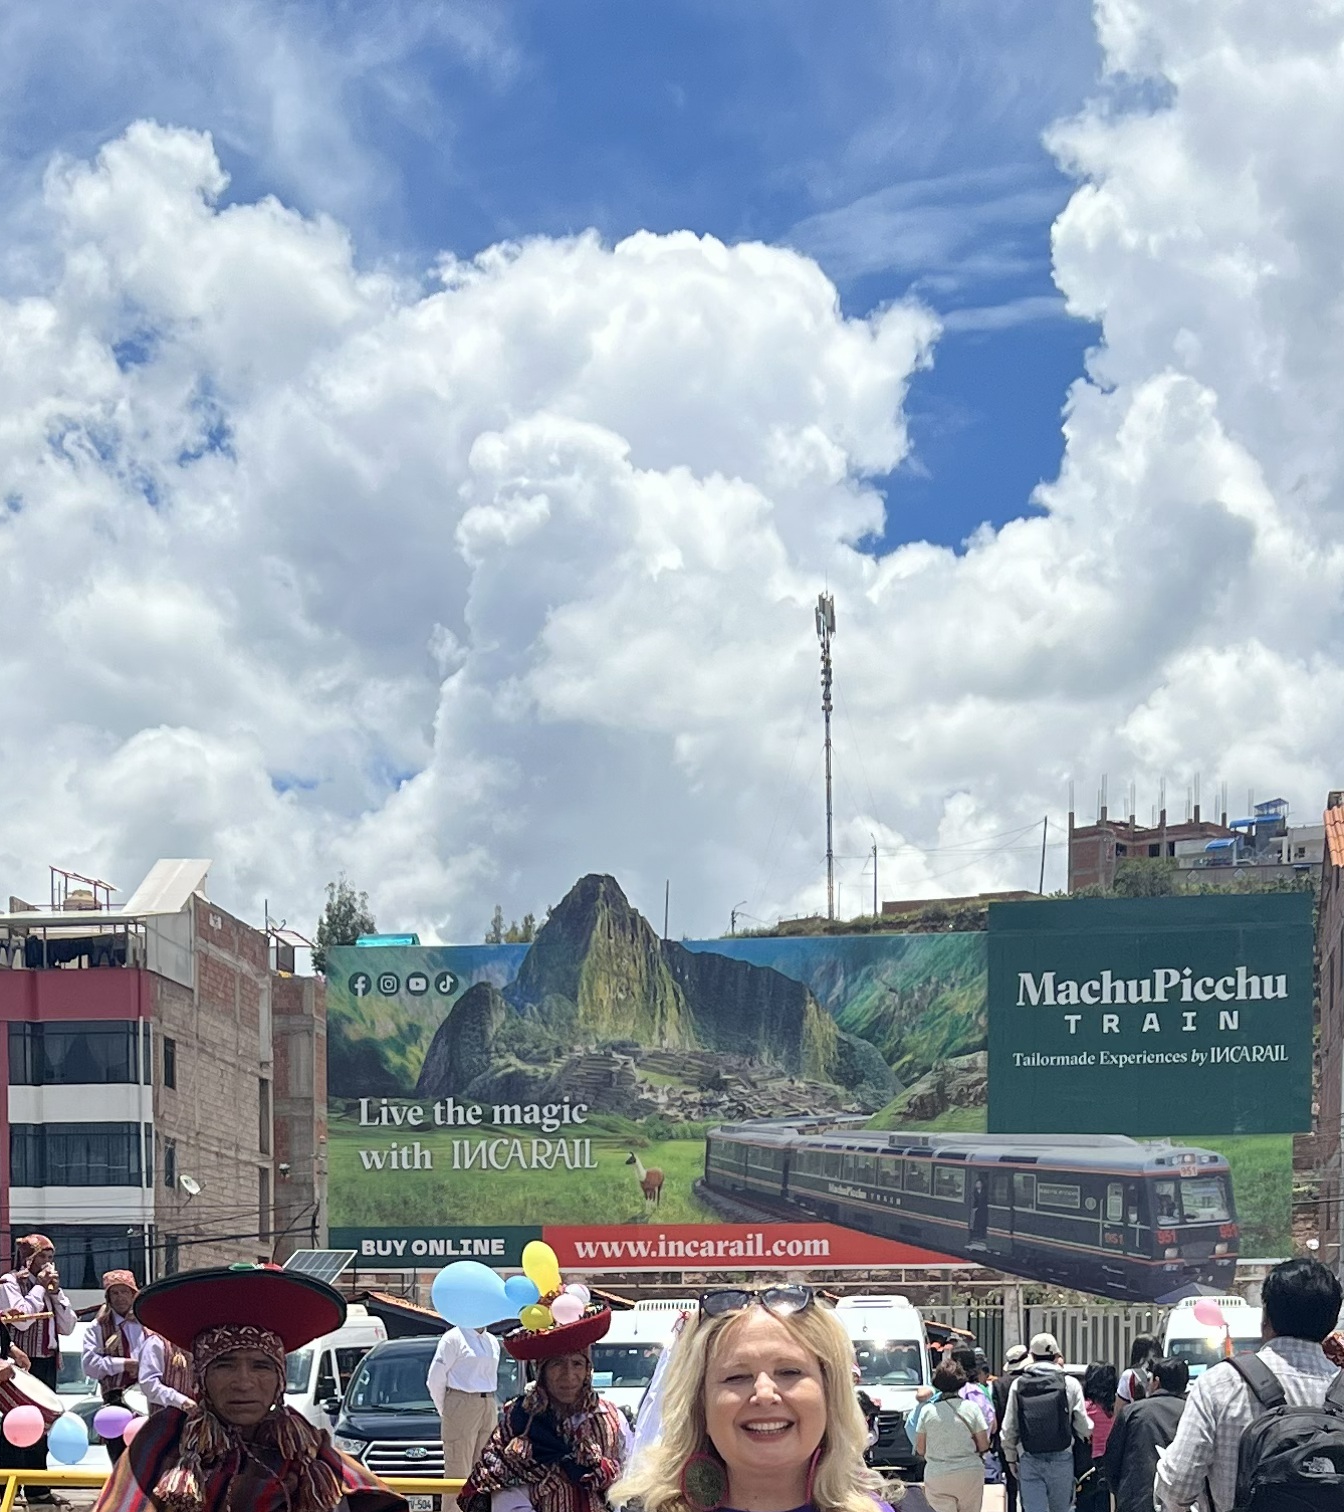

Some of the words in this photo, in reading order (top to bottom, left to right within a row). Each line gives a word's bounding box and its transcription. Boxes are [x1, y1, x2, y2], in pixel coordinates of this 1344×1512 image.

[1016, 965, 1289, 1007] MachuPicchu
[1064, 1010, 1239, 1035] TRAIN
[1012, 1051, 1096, 1067] Tailormade
[1099, 1050, 1188, 1068] Experiences
[1191, 1048, 1208, 1067] by
[1210, 1045, 1289, 1063] INCARAIL
[358, 1097, 424, 1127] Live
[433, 1097, 483, 1126] the
[492, 1096, 588, 1132] magic
[358, 1142, 433, 1170] with
[452, 1138, 599, 1170] INCARAIL
[361, 1239, 409, 1257] BUY
[411, 1238, 506, 1256] ONLINE
[574, 1233, 830, 1259] www.incarail.com
